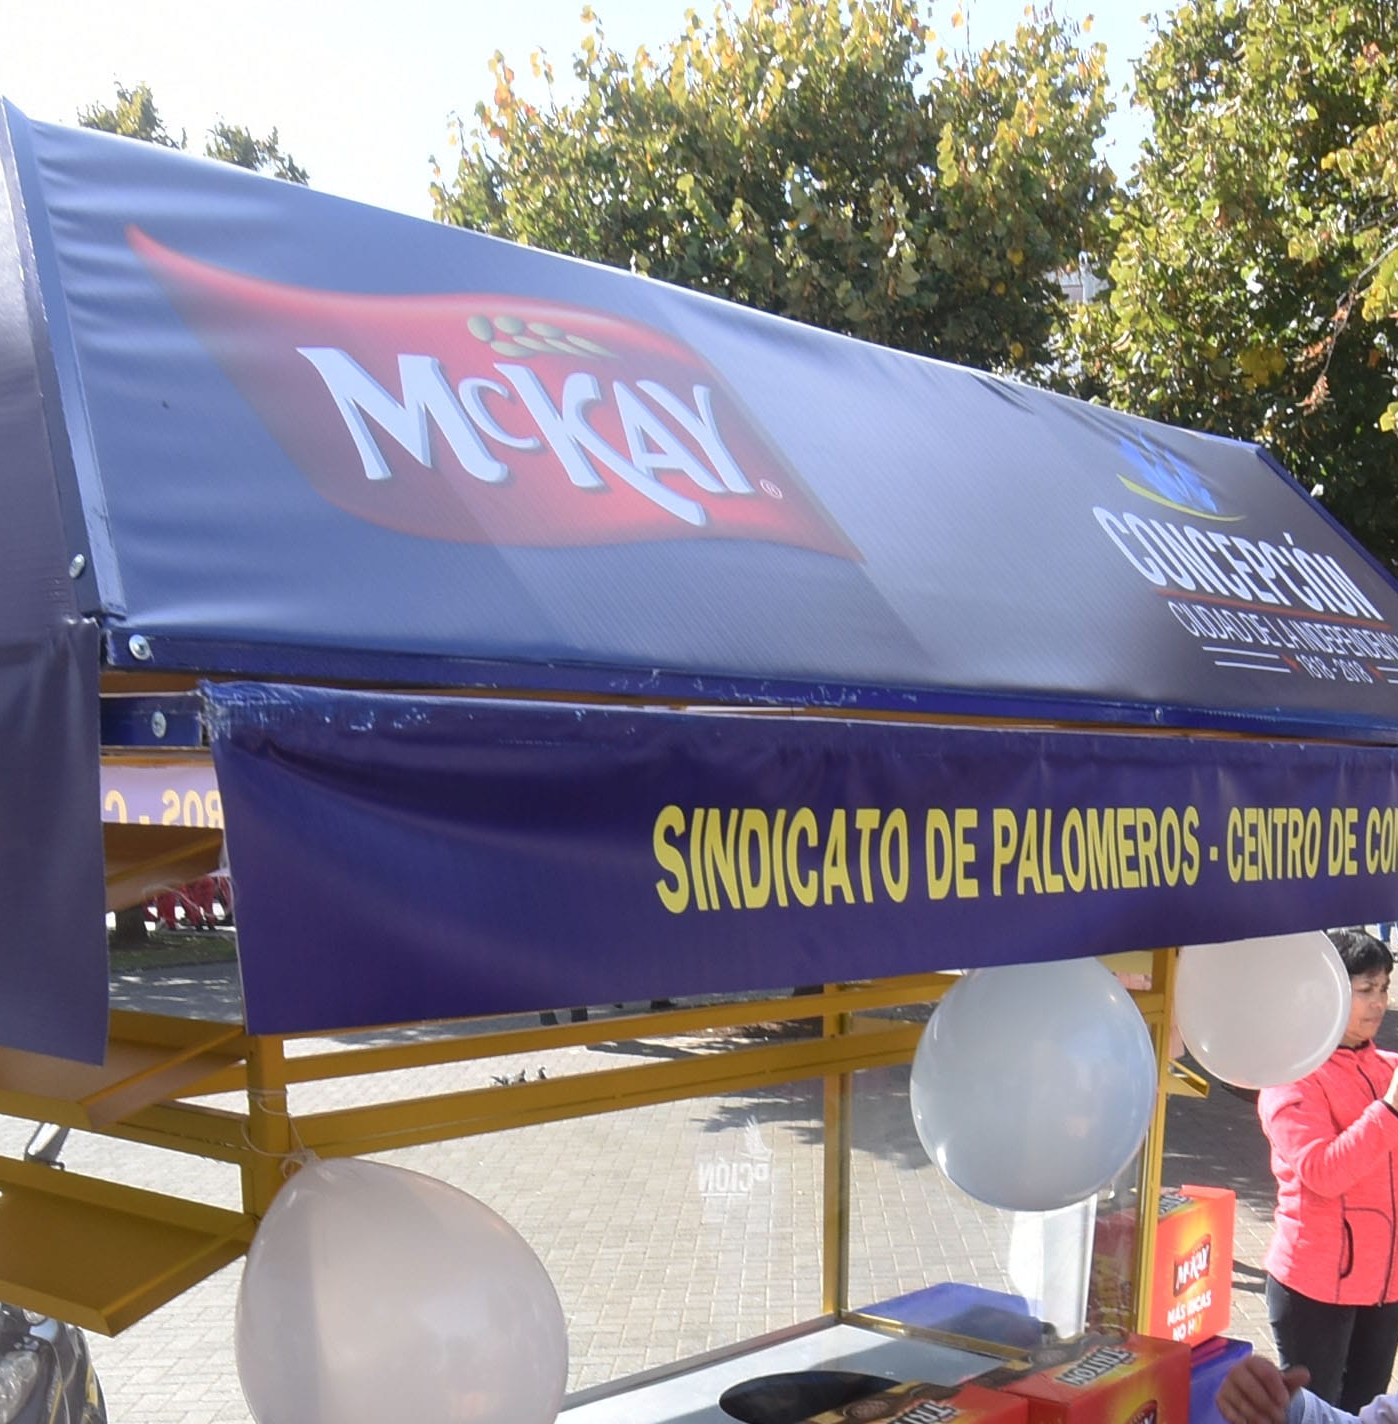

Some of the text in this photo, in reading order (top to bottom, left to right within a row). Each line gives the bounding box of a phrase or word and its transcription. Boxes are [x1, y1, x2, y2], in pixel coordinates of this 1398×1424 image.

[1093, 507, 1384, 621] CONCEPCIÓN
[1169, 603, 1260, 644] CIUDAD
[1295, 654, 1335, 680] 1818
[1332, 658, 1373, 683] 2018
[653, 805, 910, 914] SINDICATO
[926, 808, 979, 900] DE
[993, 807, 1200, 896] PALOMEROS
[1226, 807, 1322, 883] CENTRO
[1328, 808, 1358, 876] DE
